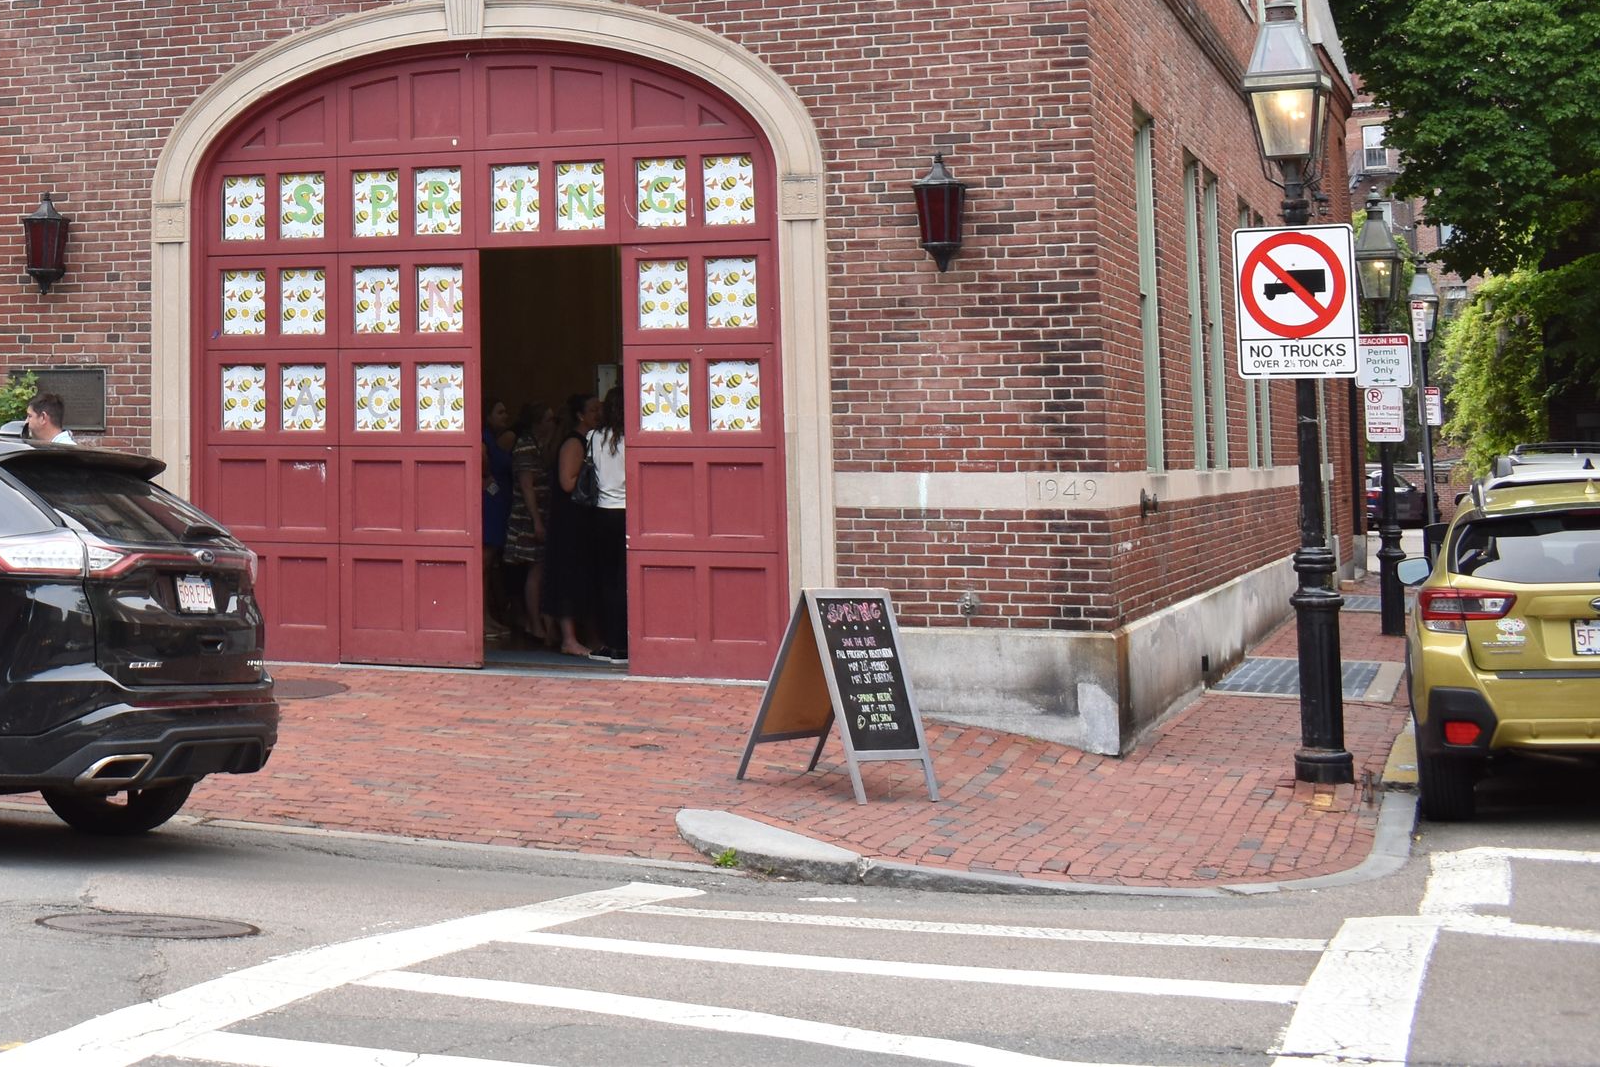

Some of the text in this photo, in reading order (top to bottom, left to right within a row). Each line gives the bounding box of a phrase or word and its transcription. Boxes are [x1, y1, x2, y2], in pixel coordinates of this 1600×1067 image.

[291, 177, 676, 226] SPRING
[374, 281, 456, 321] IN
[1250, 344, 1346, 358] NO TRUCKS
[1253, 360, 1279, 368] OVER
[1298, 359, 1318, 367] TON
[1323, 359, 1346, 367] CAP.
[1366, 358, 1400, 366] Parking
[1373, 366, 1394, 374] Only
[1038, 479, 1097, 501] 1949
[179, 585, 195, 603] 598
[826, 602, 880, 623] SPRING
[842, 636, 876, 646] SAVE THE DATE
[857, 693, 875, 702] SPRING
